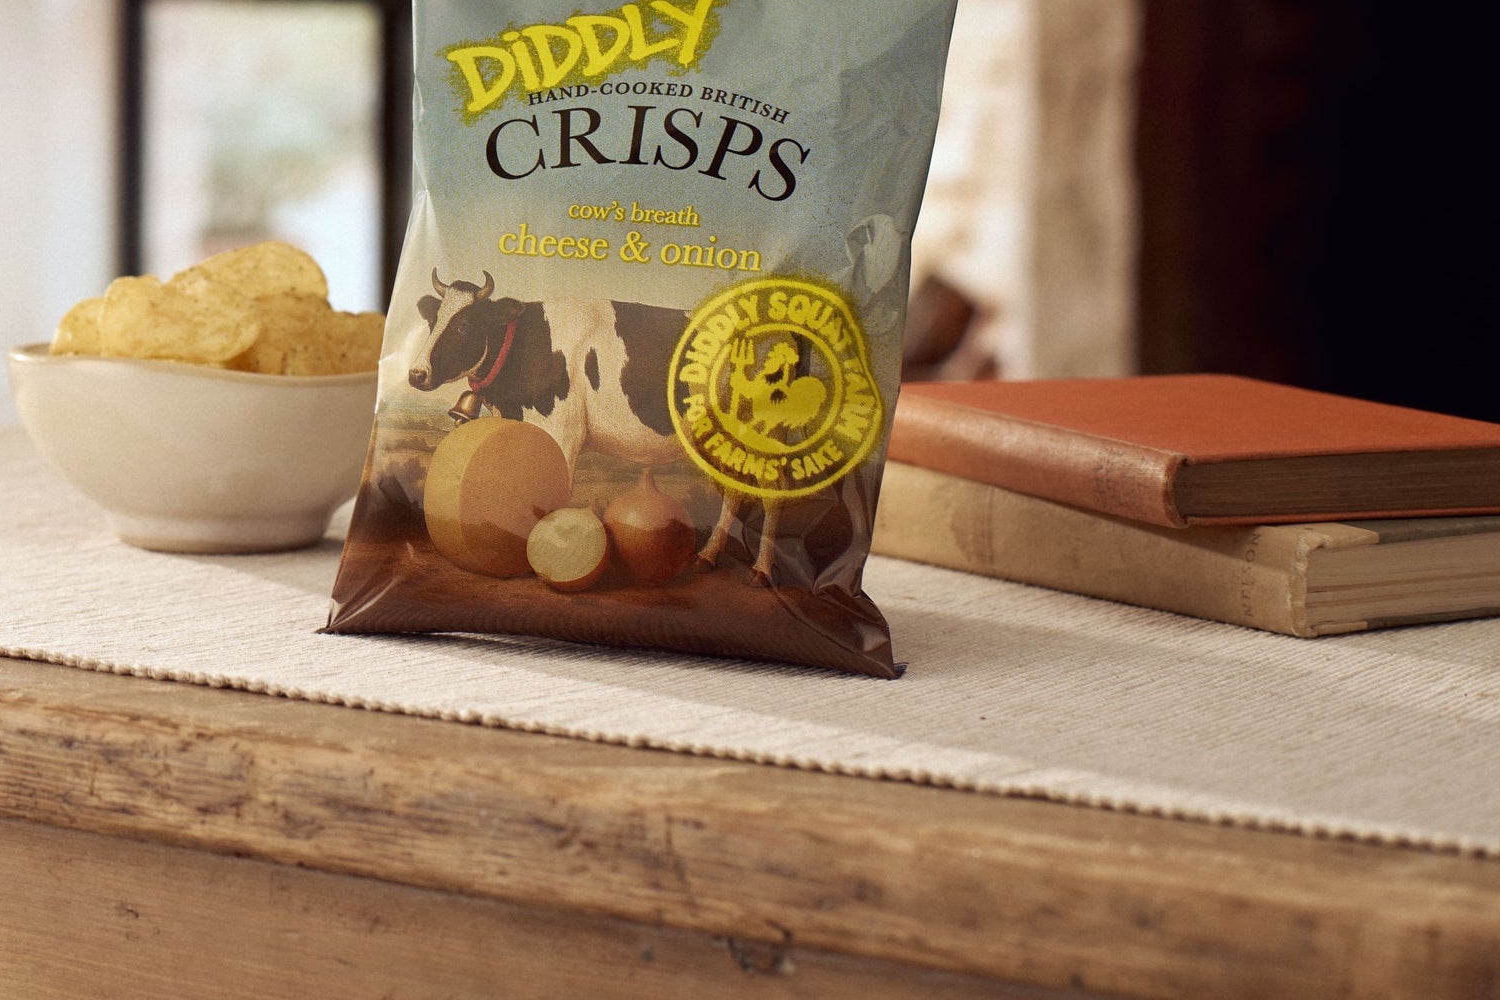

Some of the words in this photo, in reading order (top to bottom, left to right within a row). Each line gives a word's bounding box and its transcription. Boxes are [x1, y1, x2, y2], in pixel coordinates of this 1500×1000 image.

[528, 81, 694, 106] HAND-COOKED
[700, 86, 791, 125] BRITISH
[486, 105, 811, 202] CRISPS
[568, 200, 626, 221] cow's
[631, 202, 700, 227] breath
[498, 223, 610, 260] cheese
[619, 231, 651, 264] &
[660, 235, 762, 272] onion
[679, 293, 760, 384] DIDDLY
[767, 291, 853, 352] SQUAT
[790, 438, 844, 481] SAKE
